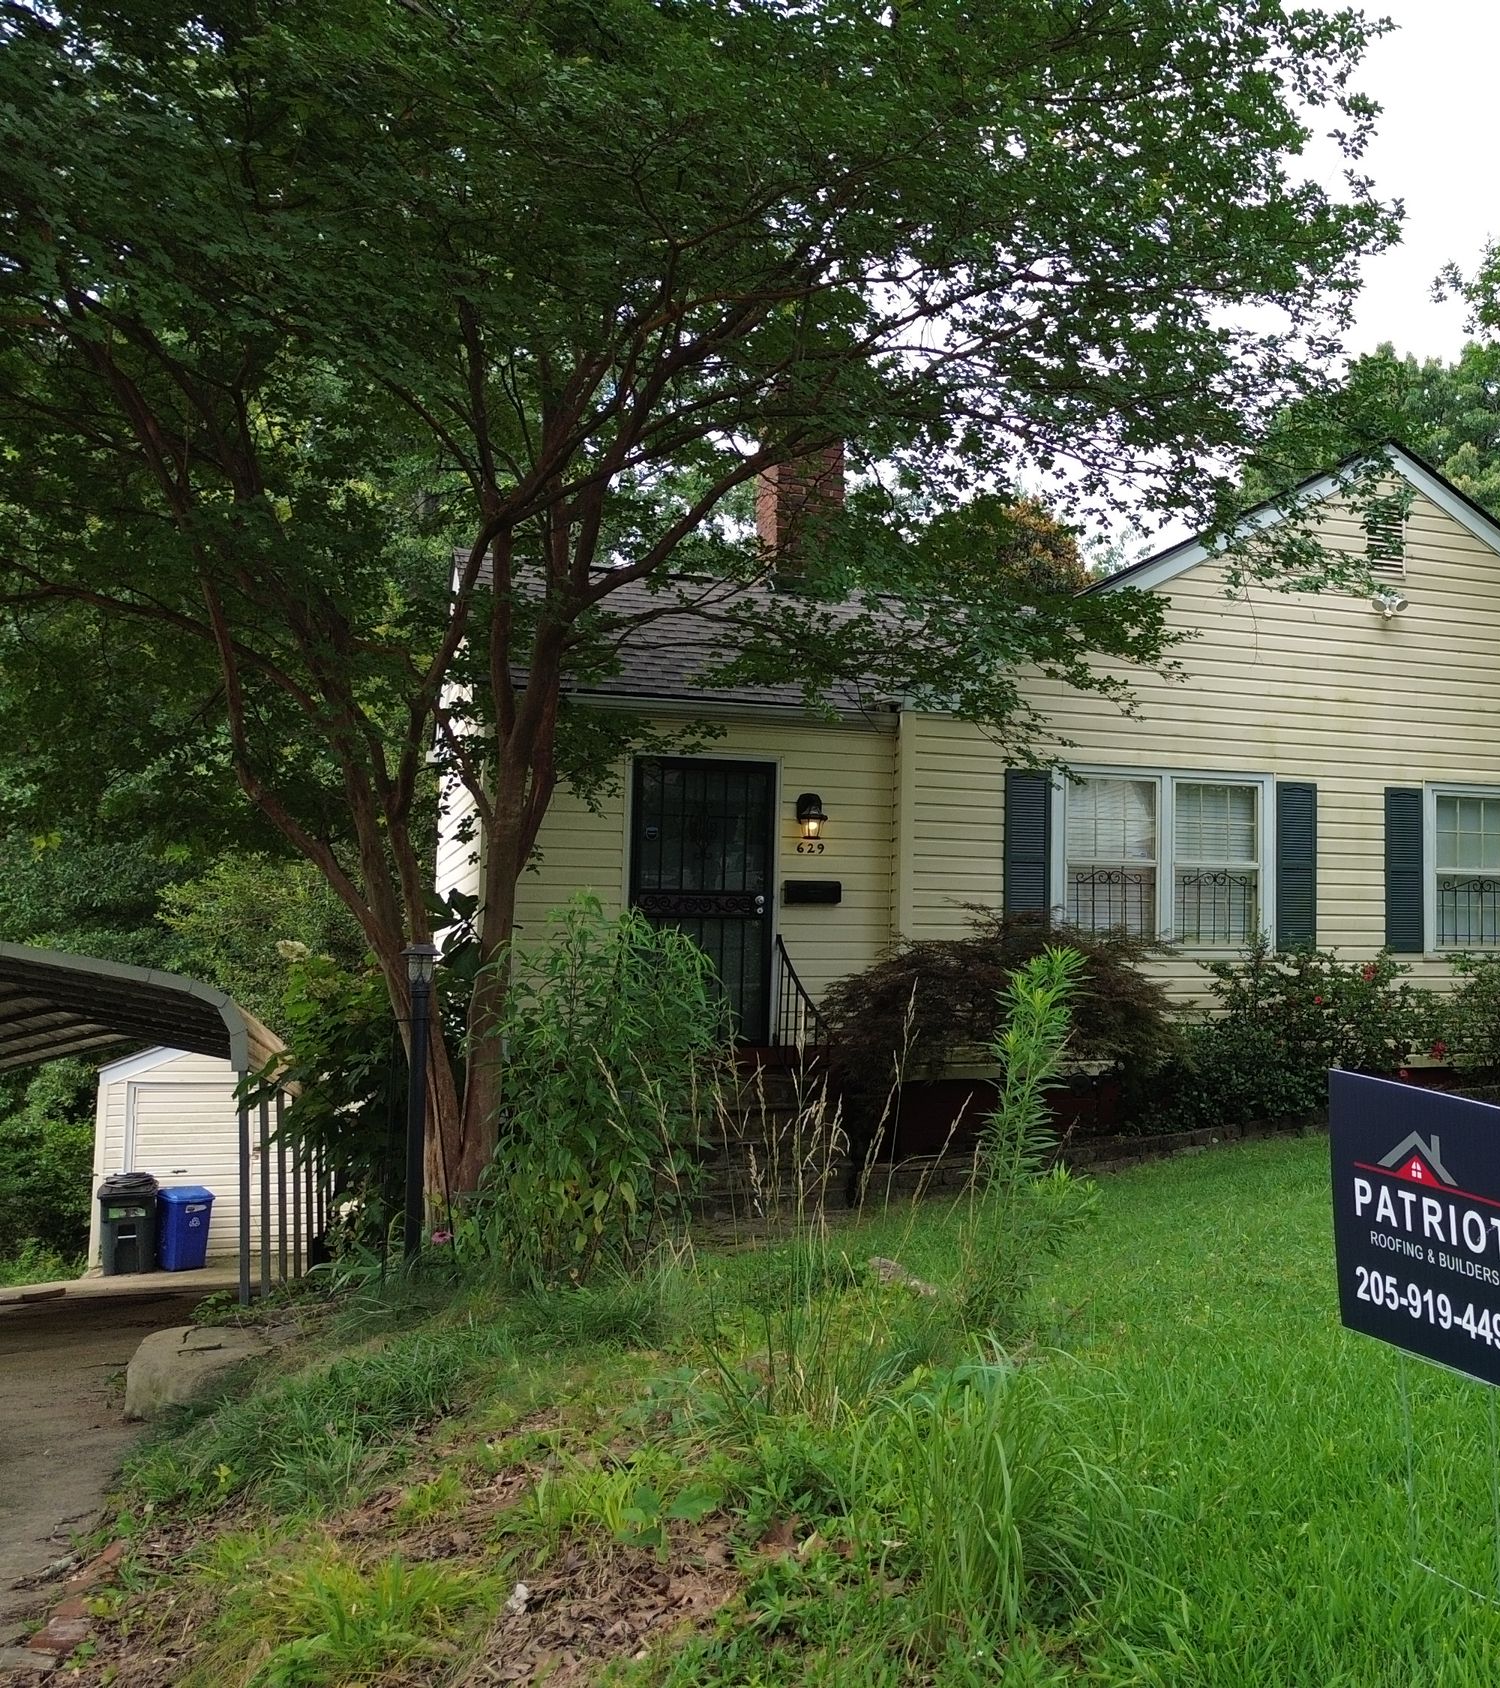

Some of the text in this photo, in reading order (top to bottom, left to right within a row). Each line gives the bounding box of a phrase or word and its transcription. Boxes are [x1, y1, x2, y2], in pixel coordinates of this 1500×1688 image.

[797, 842, 825, 854] 629
[1370, 1230, 1500, 1286] ROOFING & BUILDERS
